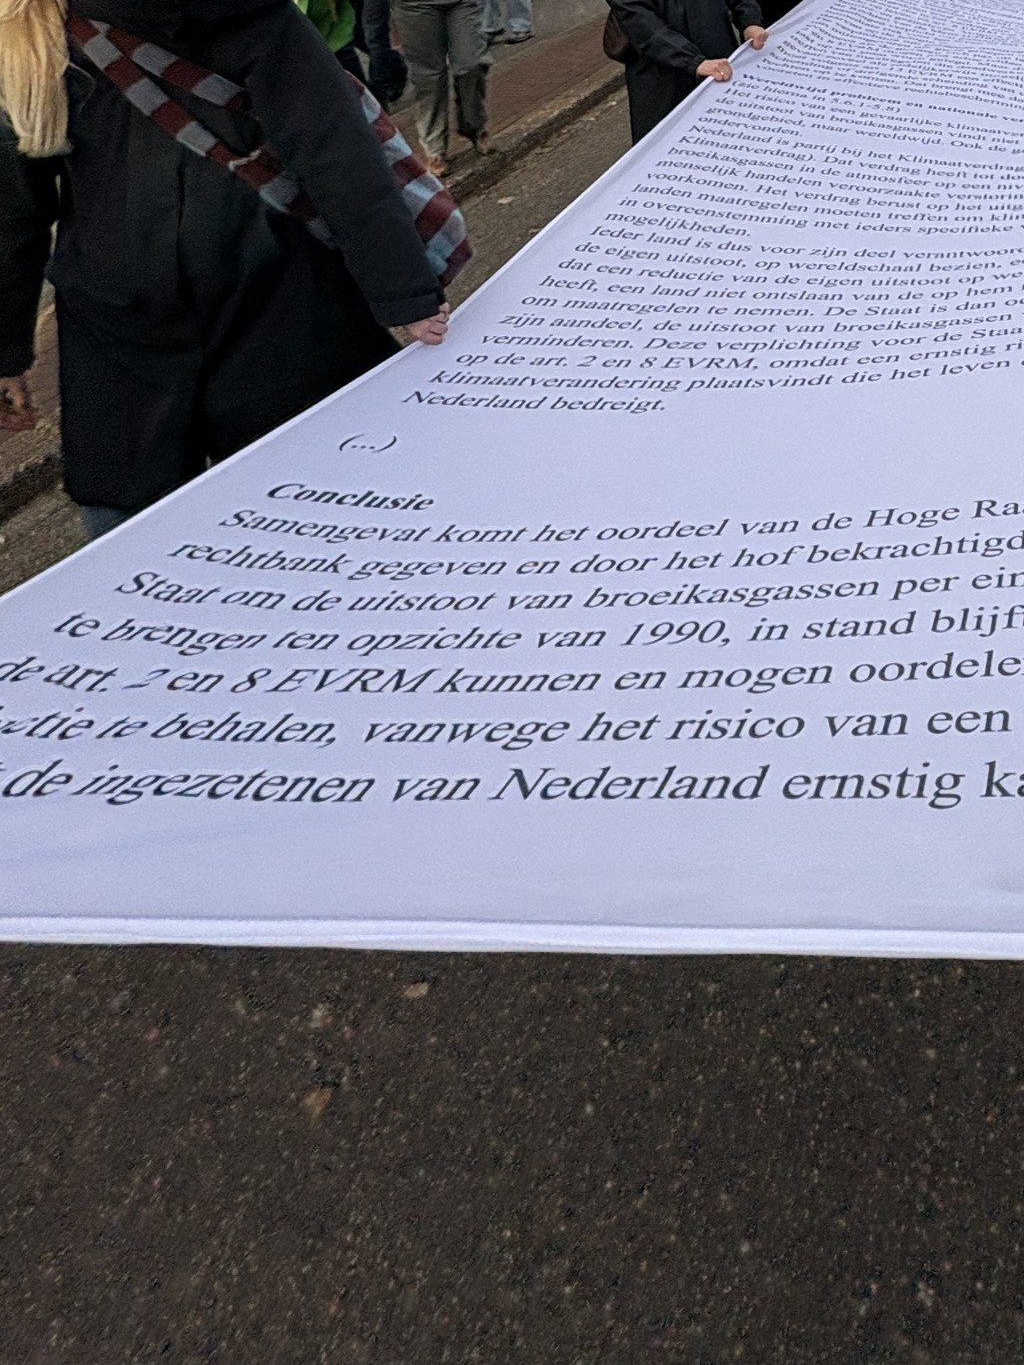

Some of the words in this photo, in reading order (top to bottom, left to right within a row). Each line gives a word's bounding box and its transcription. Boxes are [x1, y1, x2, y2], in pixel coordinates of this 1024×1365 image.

[455, 354, 489, 367] op
[493, 352, 526, 365] de
[528, 355, 568, 367] art.
[576, 355, 598, 367] 2
[601, 358, 632, 368] en
[638, 356, 658, 368] 8
[660, 356, 758, 371] EVRM,
[768, 355, 850, 369] omdat
[856, 354, 900, 365] een
[908, 343, 997, 361] ernstig
[482, 333, 634, 349] verminderen.
[642, 337, 707, 350] Deze
[716, 338, 862, 353] verplichting
[870, 336, 928, 347] voor
[931, 328, 963, 343] de
[428, 370, 682, 392] klimaatverandering
[683, 373, 835, 393] plaatsvindt
[840, 370, 882, 384] die
[888, 367, 932, 380] het
[939, 360, 1010, 376] leven
[401, 390, 548, 409] Nederland
[549, 395, 665, 414] bedreigt.
[266, 483, 434, 511] Conclusie
[218, 509, 432, 544] Samengevat
[431, 524, 528, 543] komt
[529, 523, 590, 542] het
[596, 518, 730, 541] oordeel
[740, 520, 799, 535] van
[811, 512, 853, 531] de
[862, 507, 960, 528] Hoge
[166, 544, 354, 574] rechtbank
[346, 561, 507, 581] gegeven
[515, 560, 561, 575] en
[569, 553, 659, 573] door
[661, 550, 725, 570] het
[729, 545, 805, 568] hof
[113, 571, 222, 604] Staat
[220, 590, 286, 610] om
[291, 589, 342, 612] de
[346, 589, 497, 611] uitstoot
[507, 593, 573, 610] van
[582, 581, 879, 608] broeikasgassen
[888, 576, 960, 601] per
[53, 611, 101, 638] te
[100, 618, 268, 657] brengen
[271, 629, 340, 651] ten
[346, 626, 523, 657] opzichte
[537, 630, 607, 649] van
[619, 619, 731, 648] 1990,
[746, 617, 789, 642] in
[801, 610, 917, 640] stand
[0, 655, 46, 683] de
[42, 663, 119, 693] art.
[166, 671, 225, 693] en
[229, 667, 272, 694] 8
[263, 667, 442, 693] EVRM
[432, 667, 602, 694] kunnen
[613, 670, 667, 691] en
[676, 665, 833, 694] mogen
[94, 715, 149, 739] te
[149, 711, 336, 748] behalen,
[363, 721, 571, 751] vanwege
[576, 711, 661, 742] het
[665, 709, 805, 740] risico
[824, 713, 909, 737] van
[926, 709, 1012, 735] een
[1, 758, 74, 798] de
[68, 765, 376, 806] ingezetenen
[391, 777, 481, 802] van
[487, 763, 770, 800] Nederland
[781, 762, 966, 810] ernstig
